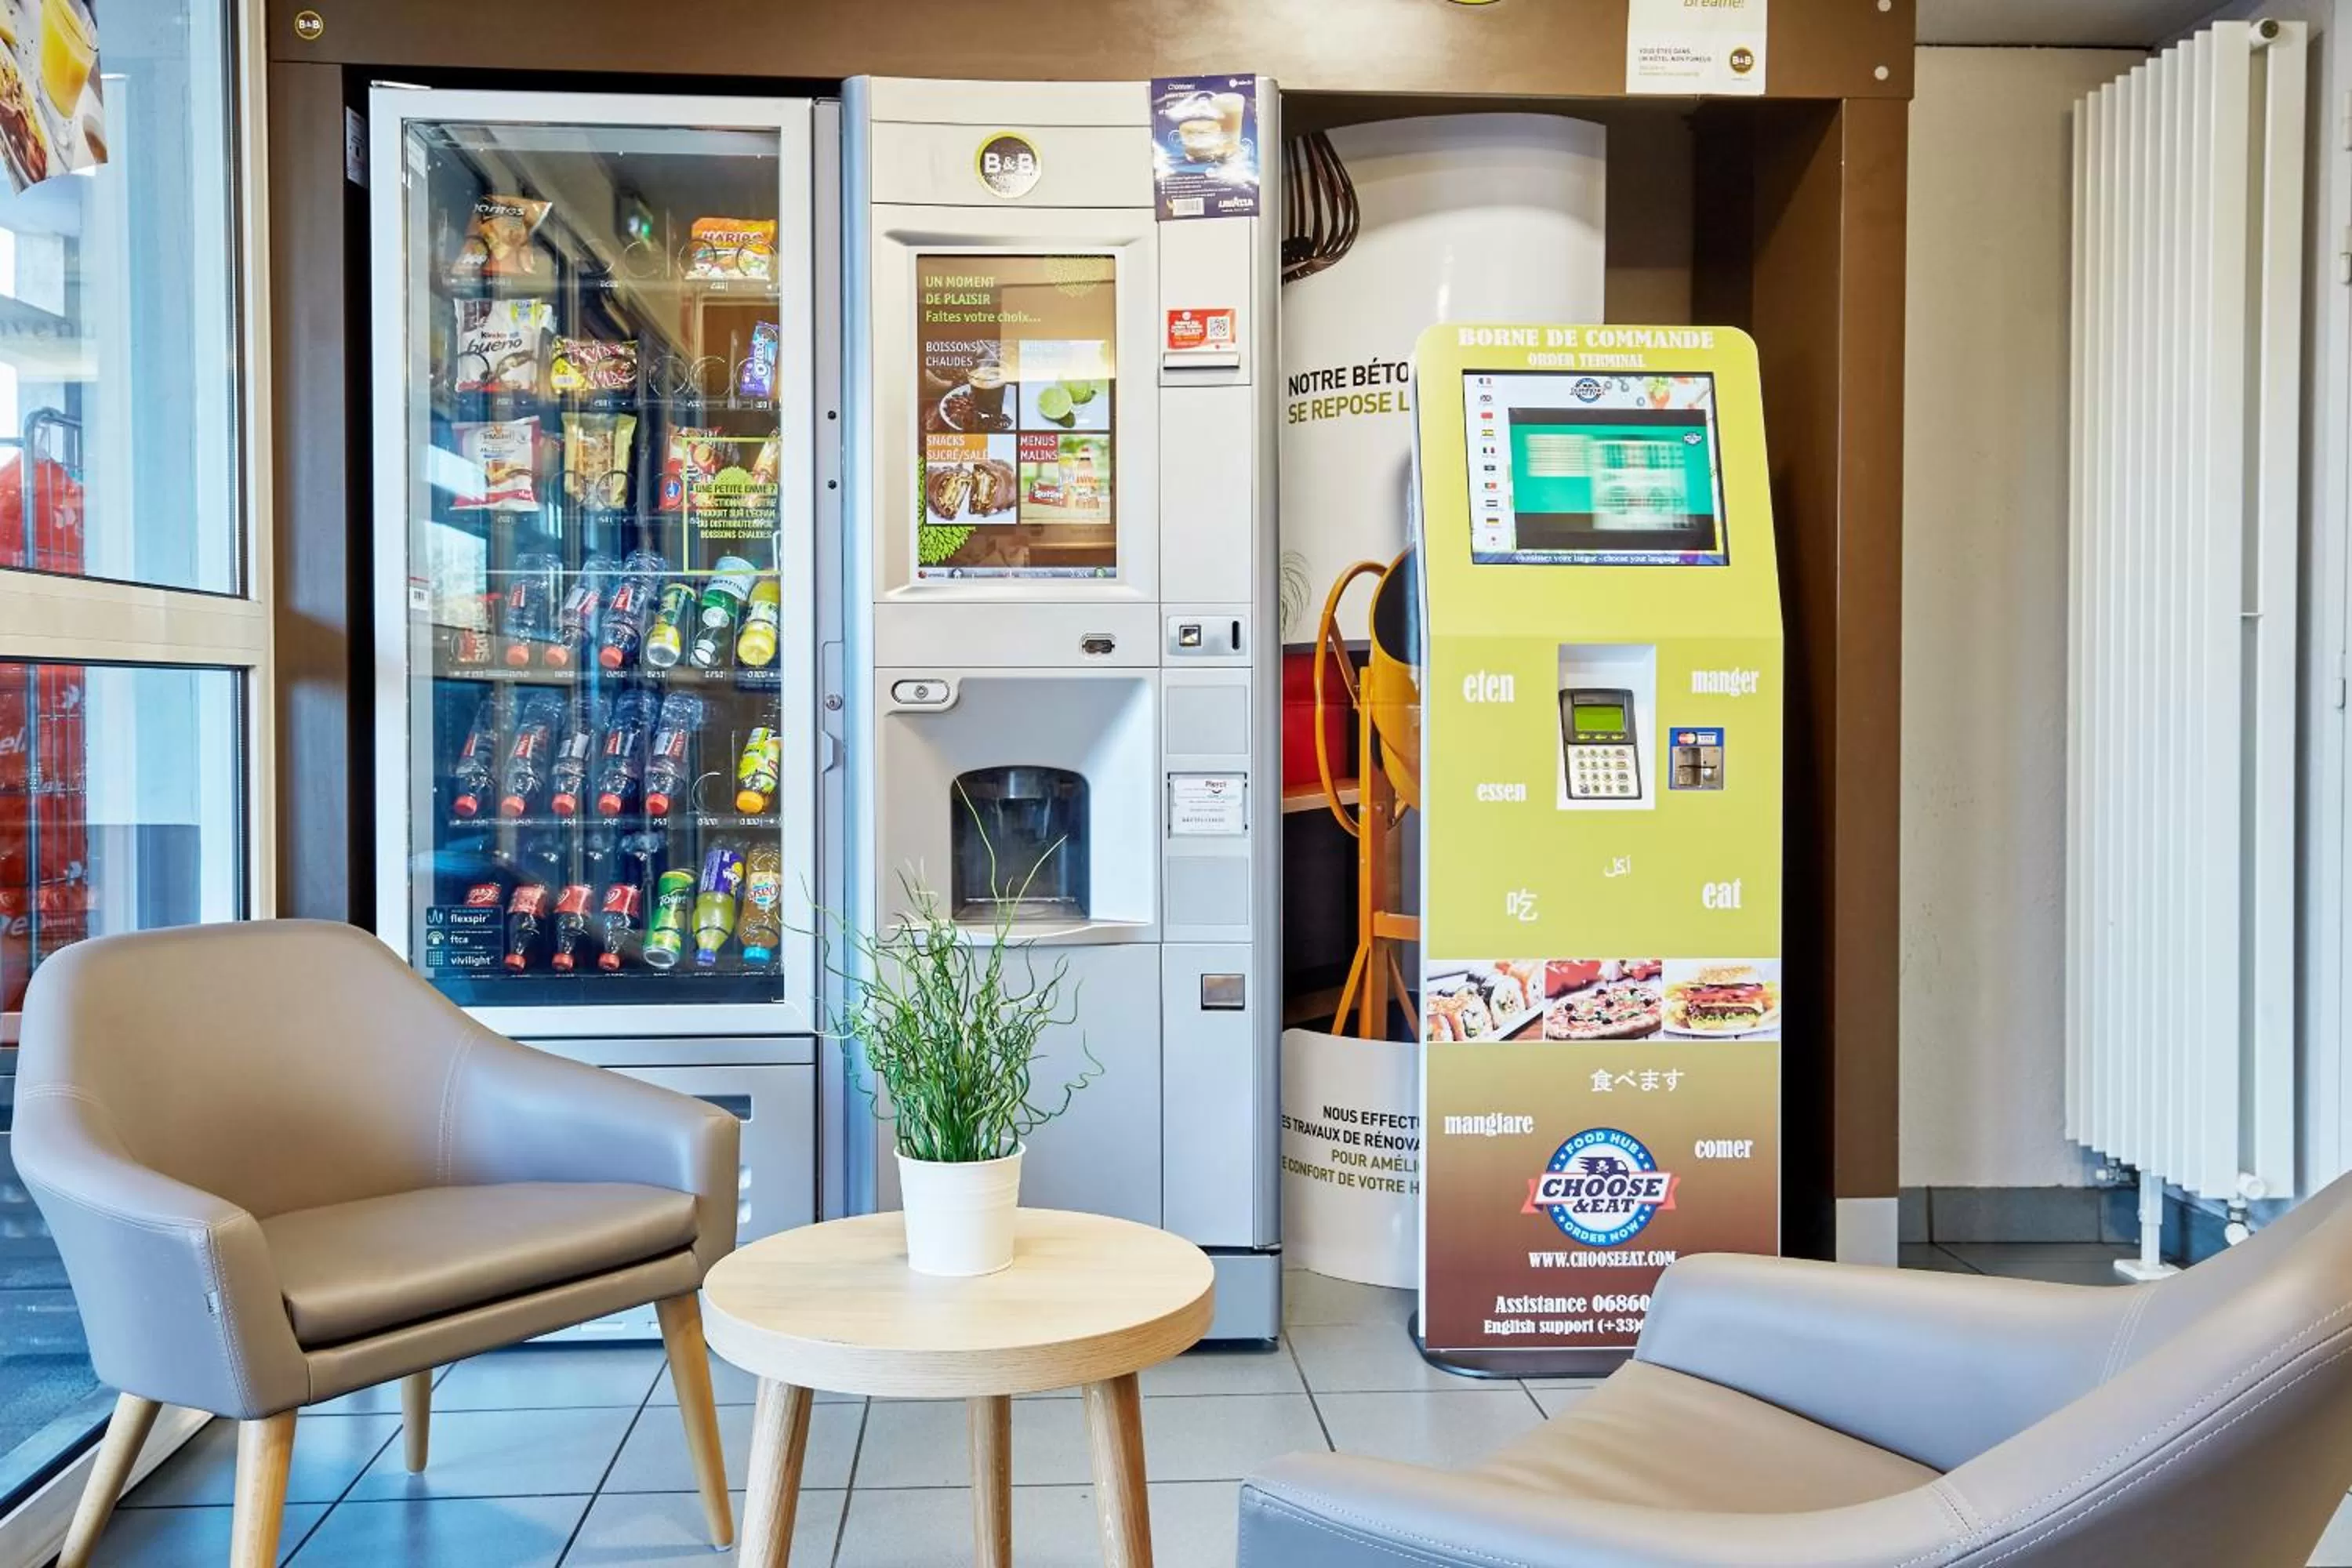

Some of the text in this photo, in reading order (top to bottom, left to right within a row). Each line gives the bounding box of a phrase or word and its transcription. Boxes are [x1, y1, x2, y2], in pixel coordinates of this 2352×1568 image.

[925, 277, 996, 288] UN MOMENT
[926, 293, 990, 305] DE PLAISIR
[925, 310, 961, 322] Faites
[964, 312, 996, 322] votre
[925, 341, 978, 352] BOISSONS
[1458, 327, 1715, 349] BORNE DE COMMANDE
[925, 356, 974, 366] CHAUDES
[1527, 352, 1646, 368] ORDER TERMINAL
[1288, 358, 1409, 397] NOTRE BÉTO
[1288, 401, 1307, 424] SE
[1312, 392, 1392, 421] REPOSE
[927, 434, 965, 445] SNACKS
[1020, 434, 1056, 445] MENUS
[1020, 449, 1058, 460] MALINS
[1463, 669, 1515, 703] eten
[1691, 667, 1760, 697] manger
[1476, 782, 1526, 804] essen
[1701, 878, 1742, 909] eat
[1506, 887, 1538, 921] 吃
[1590, 1068, 1684, 1092] 食べます
[1323, 1105, 1357, 1123] NOUS
[1294, 1117, 1341, 1142] TRAVAUX
[1343, 1130, 1361, 1145] DE
[1565, 1131, 1641, 1155] FOOD HUB
[1694, 1138, 1753, 1160] comer
[1331, 1149, 1419, 1173] POUR AMÉLI
[1288, 1159, 1334, 1183] CONFORT
[1338, 1172, 1356, 1187] DE
[1358, 1176, 1406, 1193] VOTRE
[1542, 1178, 1663, 1197] CHOOSE
[1572, 1199, 1635, 1214] &EAT
[1564, 1221, 1640, 1243] ORDER NOW
[1528, 1251, 1676, 1268] WWW.CHOOSEEAT.COM
[1494, 1295, 1588, 1314] Assistance
[1483, 1319, 1535, 1335] English
[1539, 1319, 1594, 1335] support
